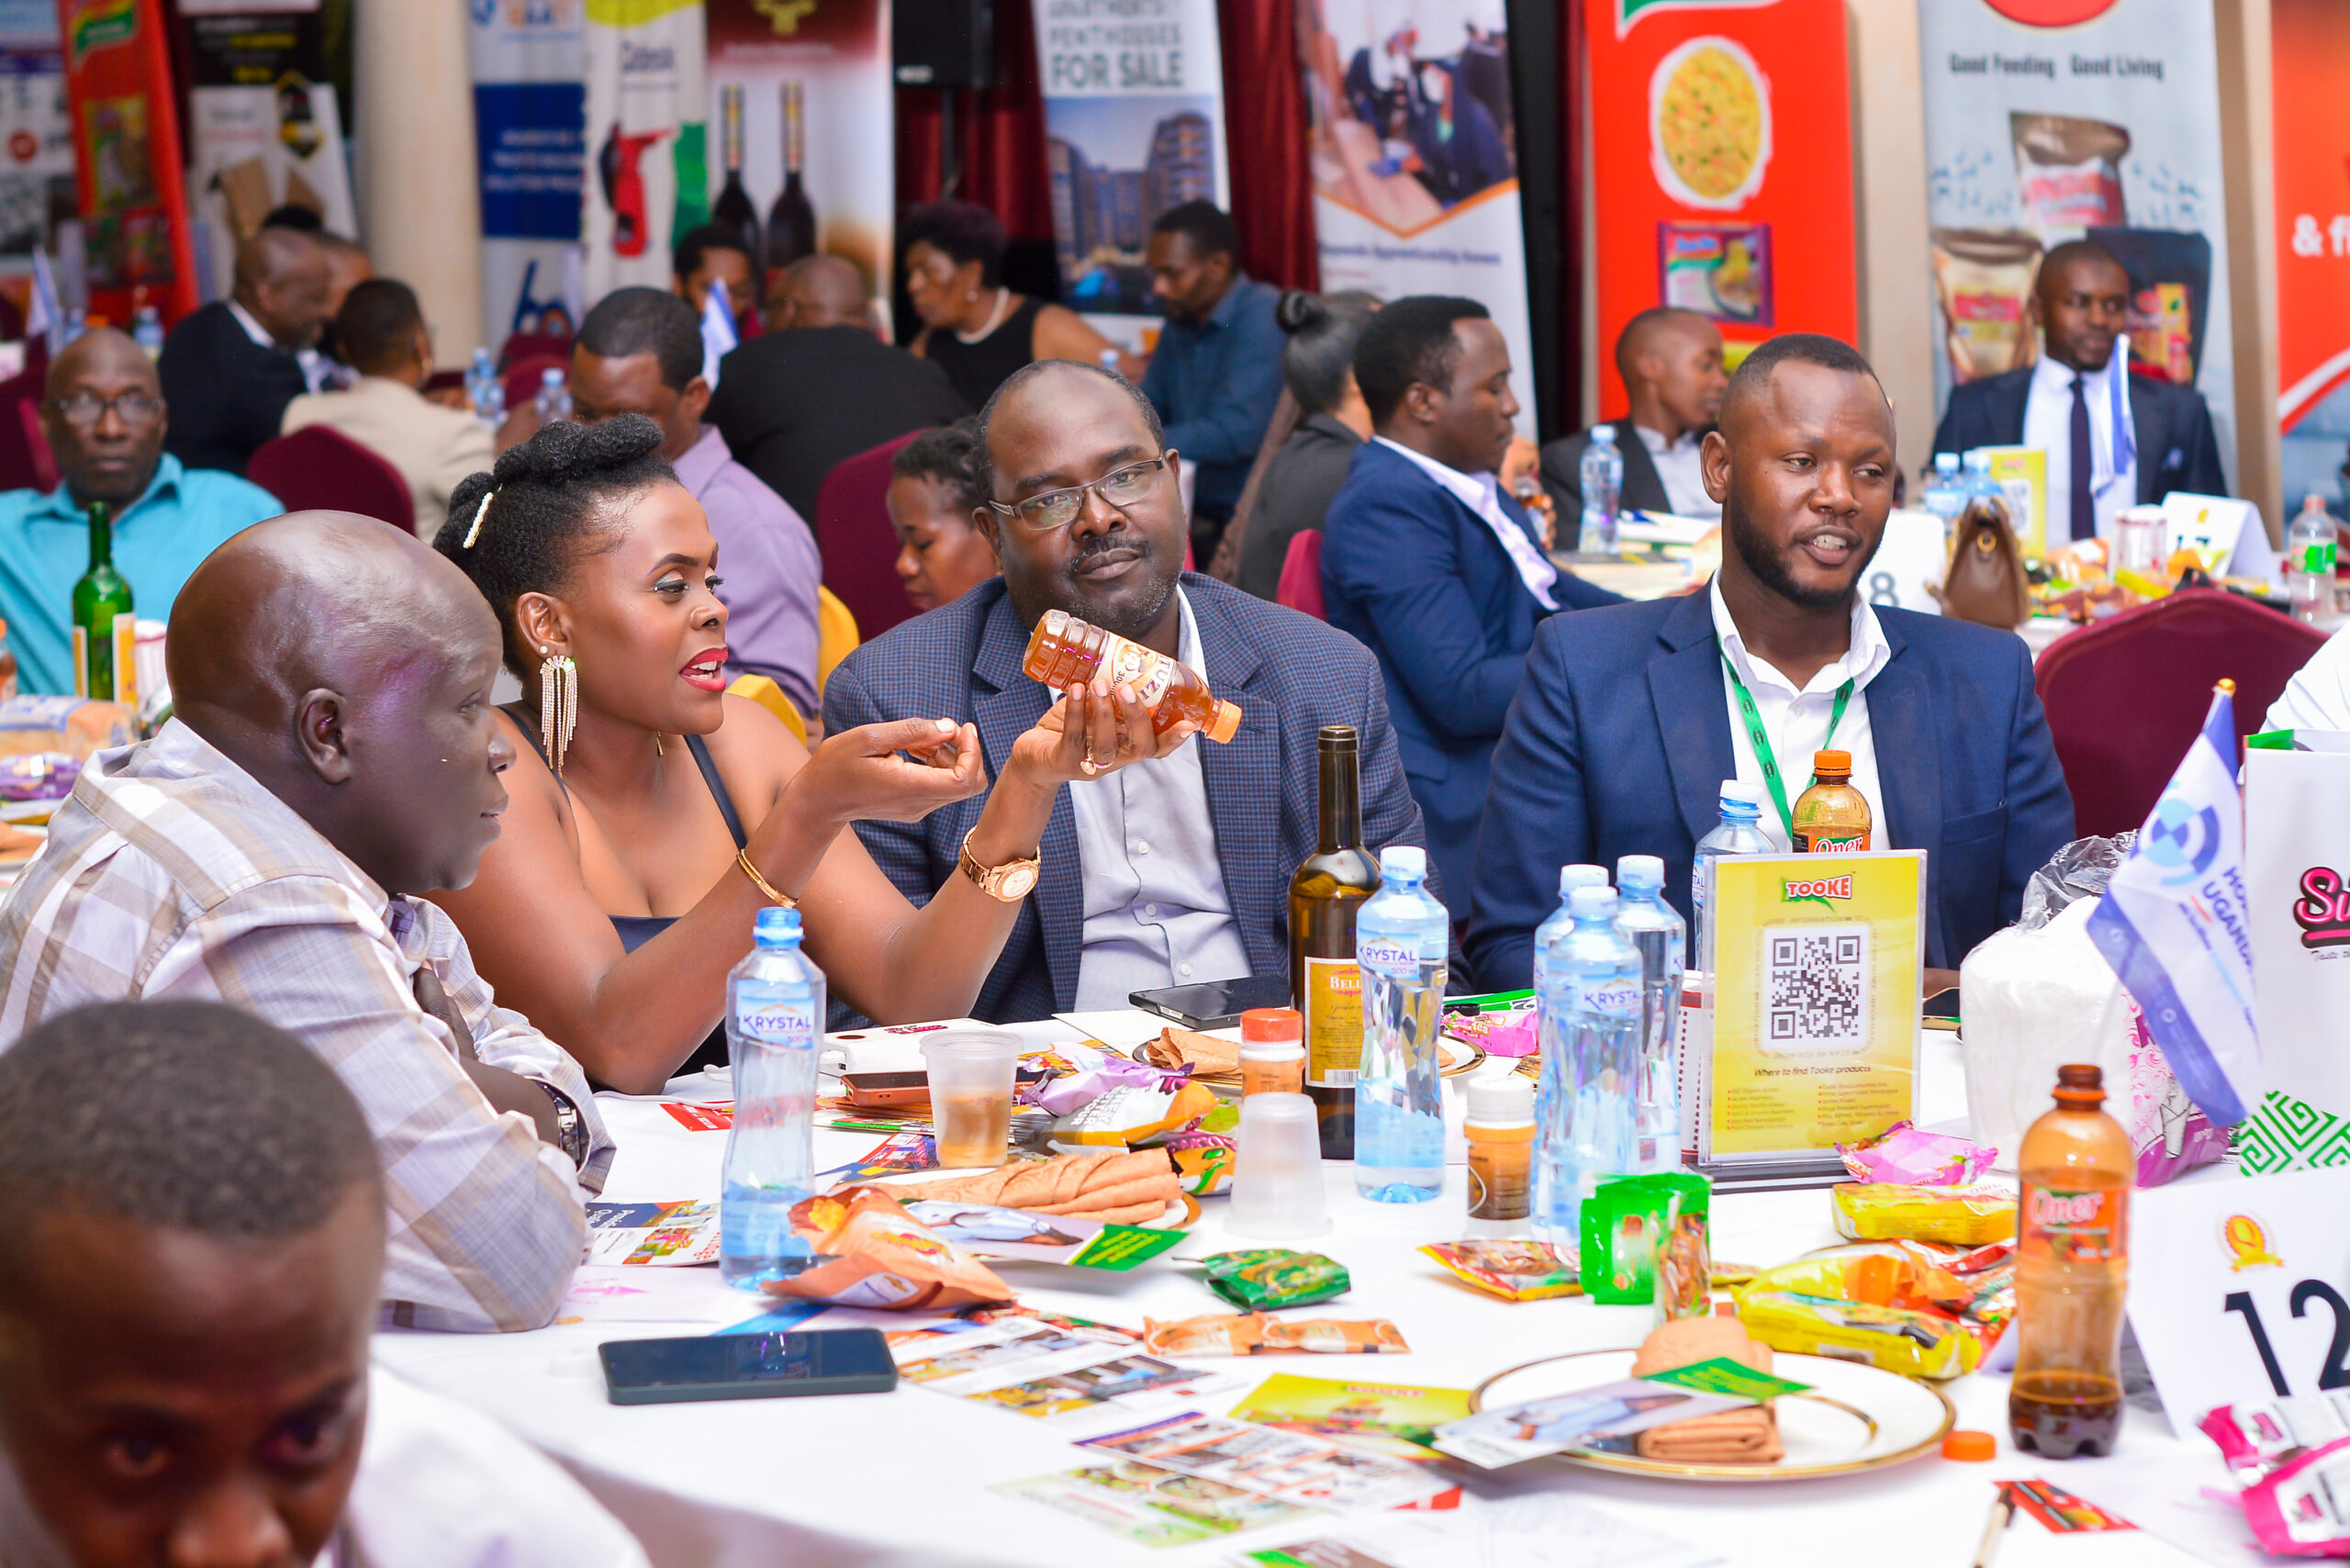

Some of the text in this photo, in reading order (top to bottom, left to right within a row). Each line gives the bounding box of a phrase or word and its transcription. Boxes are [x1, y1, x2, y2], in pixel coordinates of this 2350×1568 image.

[1051, 50, 1183, 89] FOR SALE
[1949, 52, 2165, 83] Good Feeding Good Living
[2291, 213, 2324, 257] &
[1785, 875, 1852, 900] TOOKE
[1359, 946, 1417, 965] KRYSTAL
[1391, 967, 1407, 975] 500
[743, 1014, 811, 1036] KRYSTAL
[1754, 1065, 1872, 1077] Where to find Tooke products
[2027, 1188, 2105, 1225] Oner
[2224, 1279, 2350, 1397] 12
